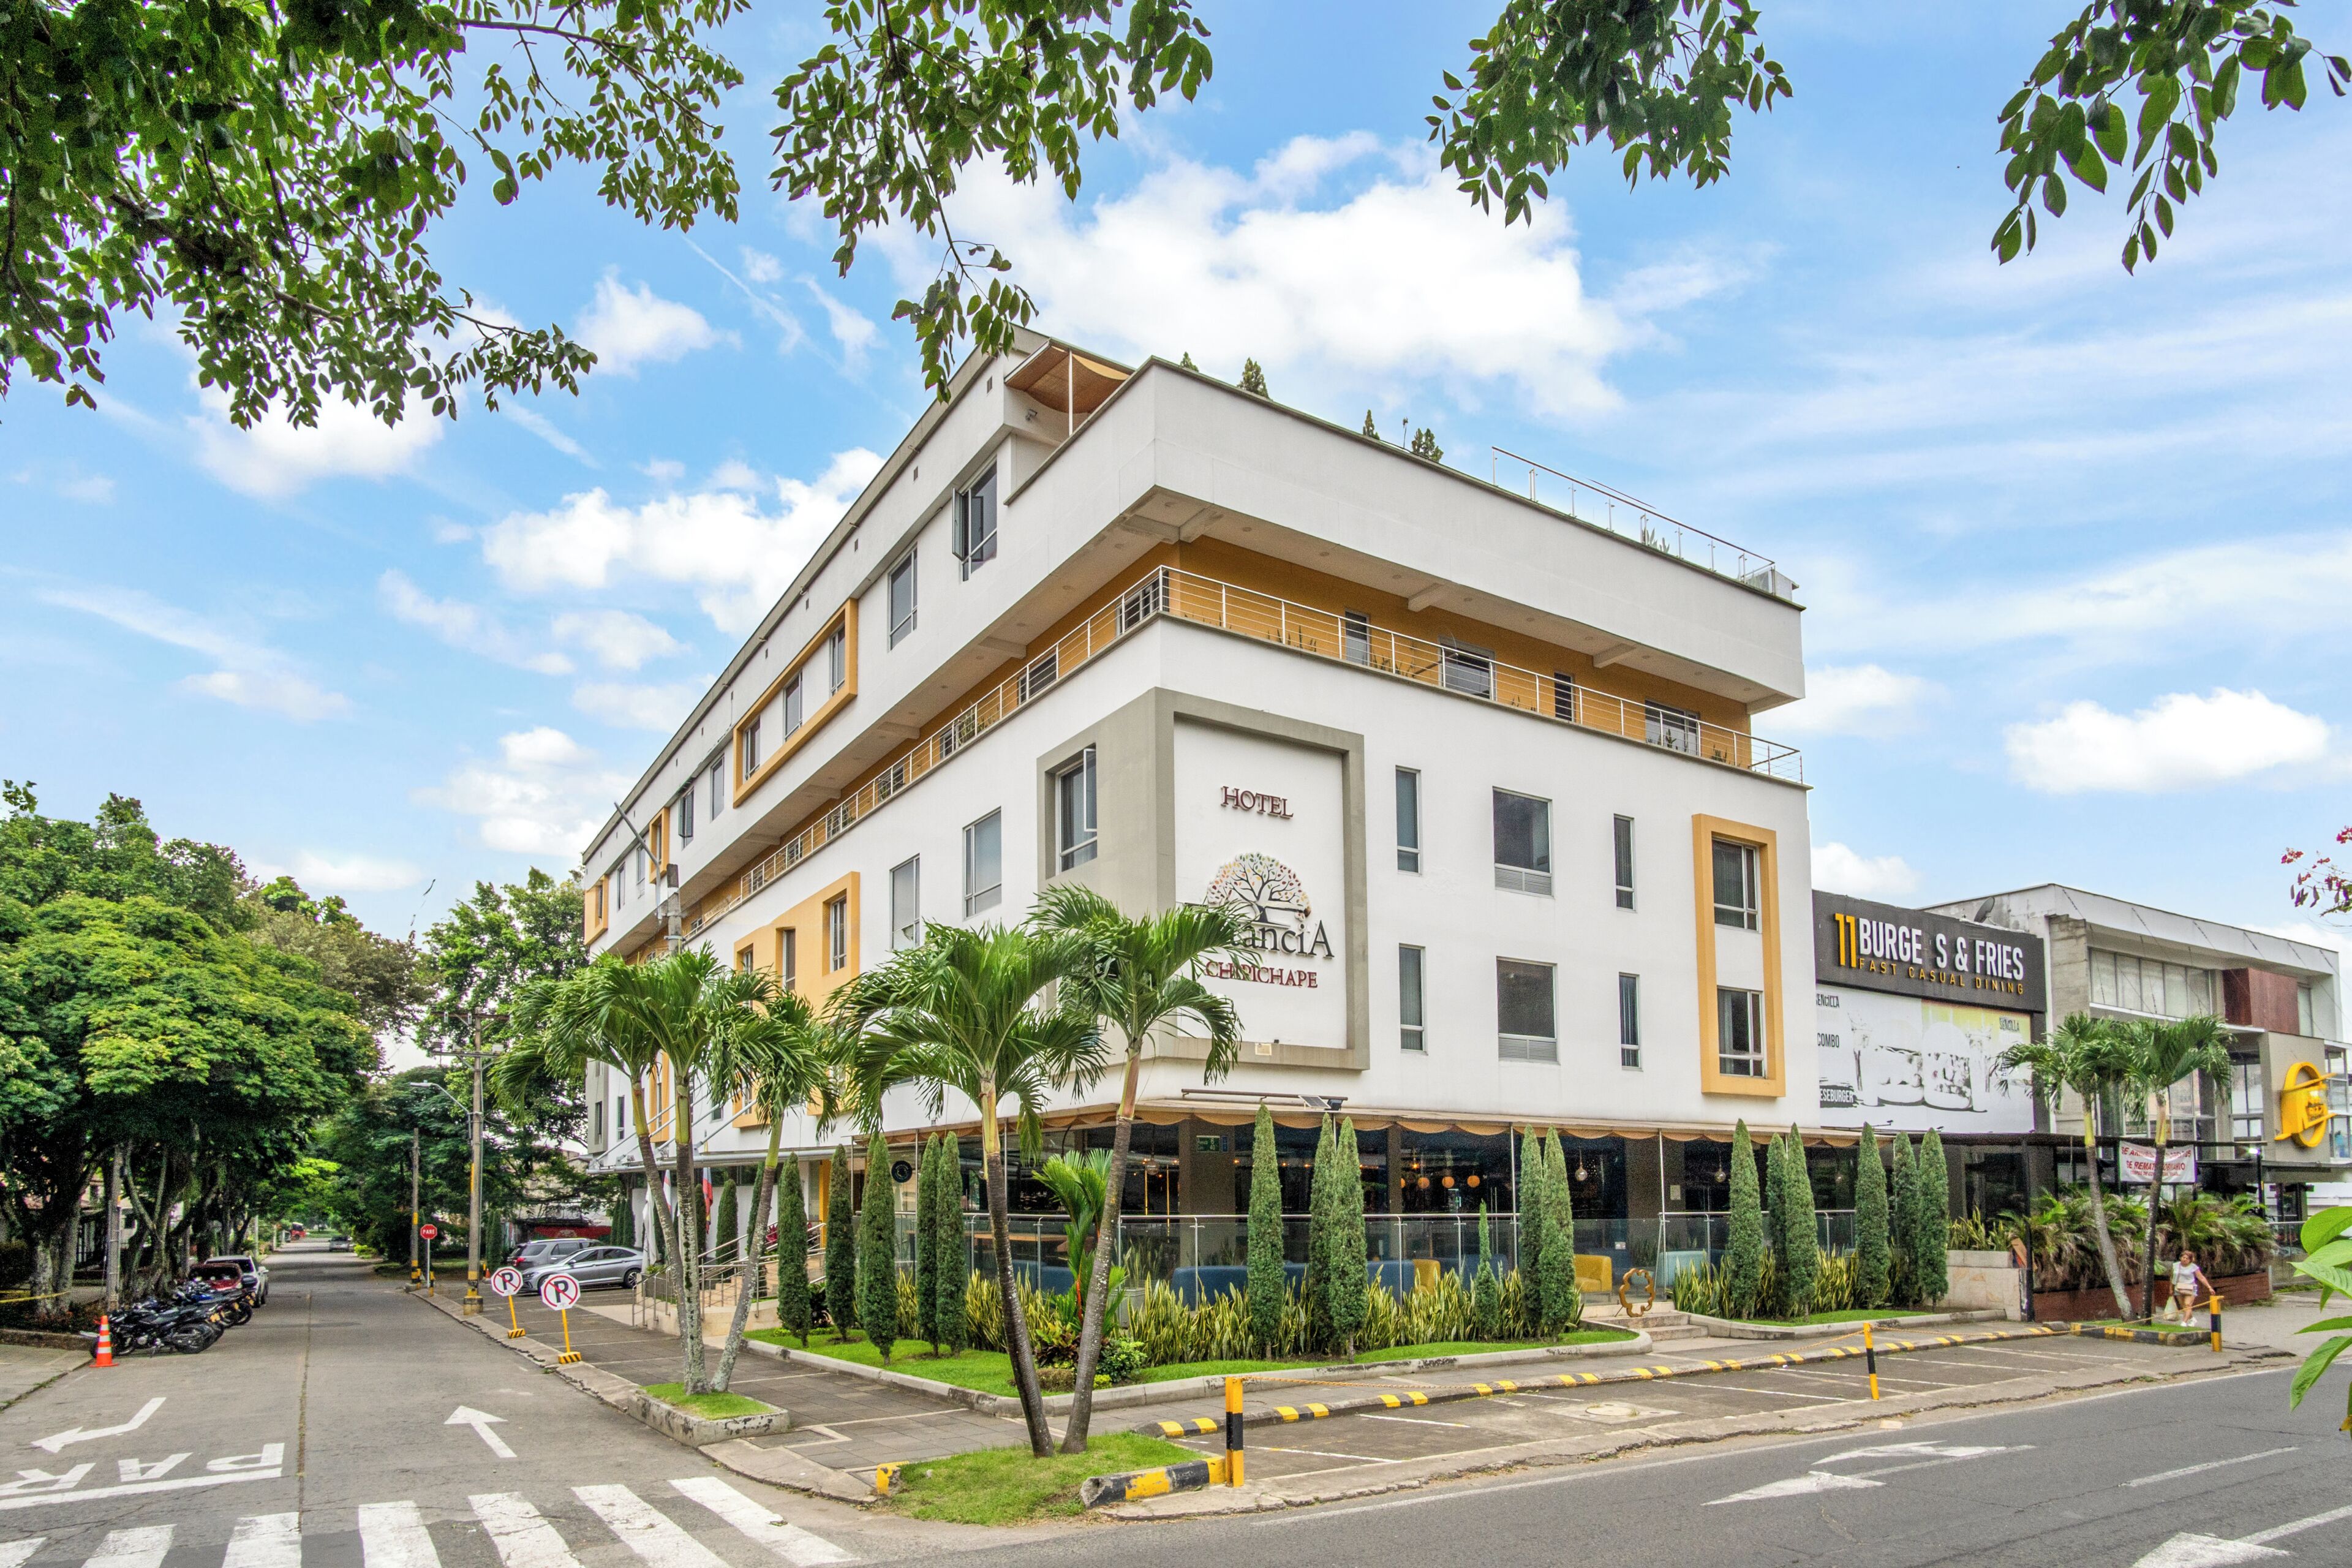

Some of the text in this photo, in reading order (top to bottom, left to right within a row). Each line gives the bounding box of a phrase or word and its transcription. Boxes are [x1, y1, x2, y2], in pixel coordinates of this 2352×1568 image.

[1221, 785, 1294, 818] HOTEL
[1835, 913, 1856, 968] 11
[1955, 937, 1969, 972] &
[1975, 940, 2024, 981] FRIES
[1859, 958, 2024, 995] FAST CASUAL DINING
[1817, 1032, 1840, 1048] COMBO
[501, 1272, 514, 1291] P
[554, 1280, 569, 1303] P
